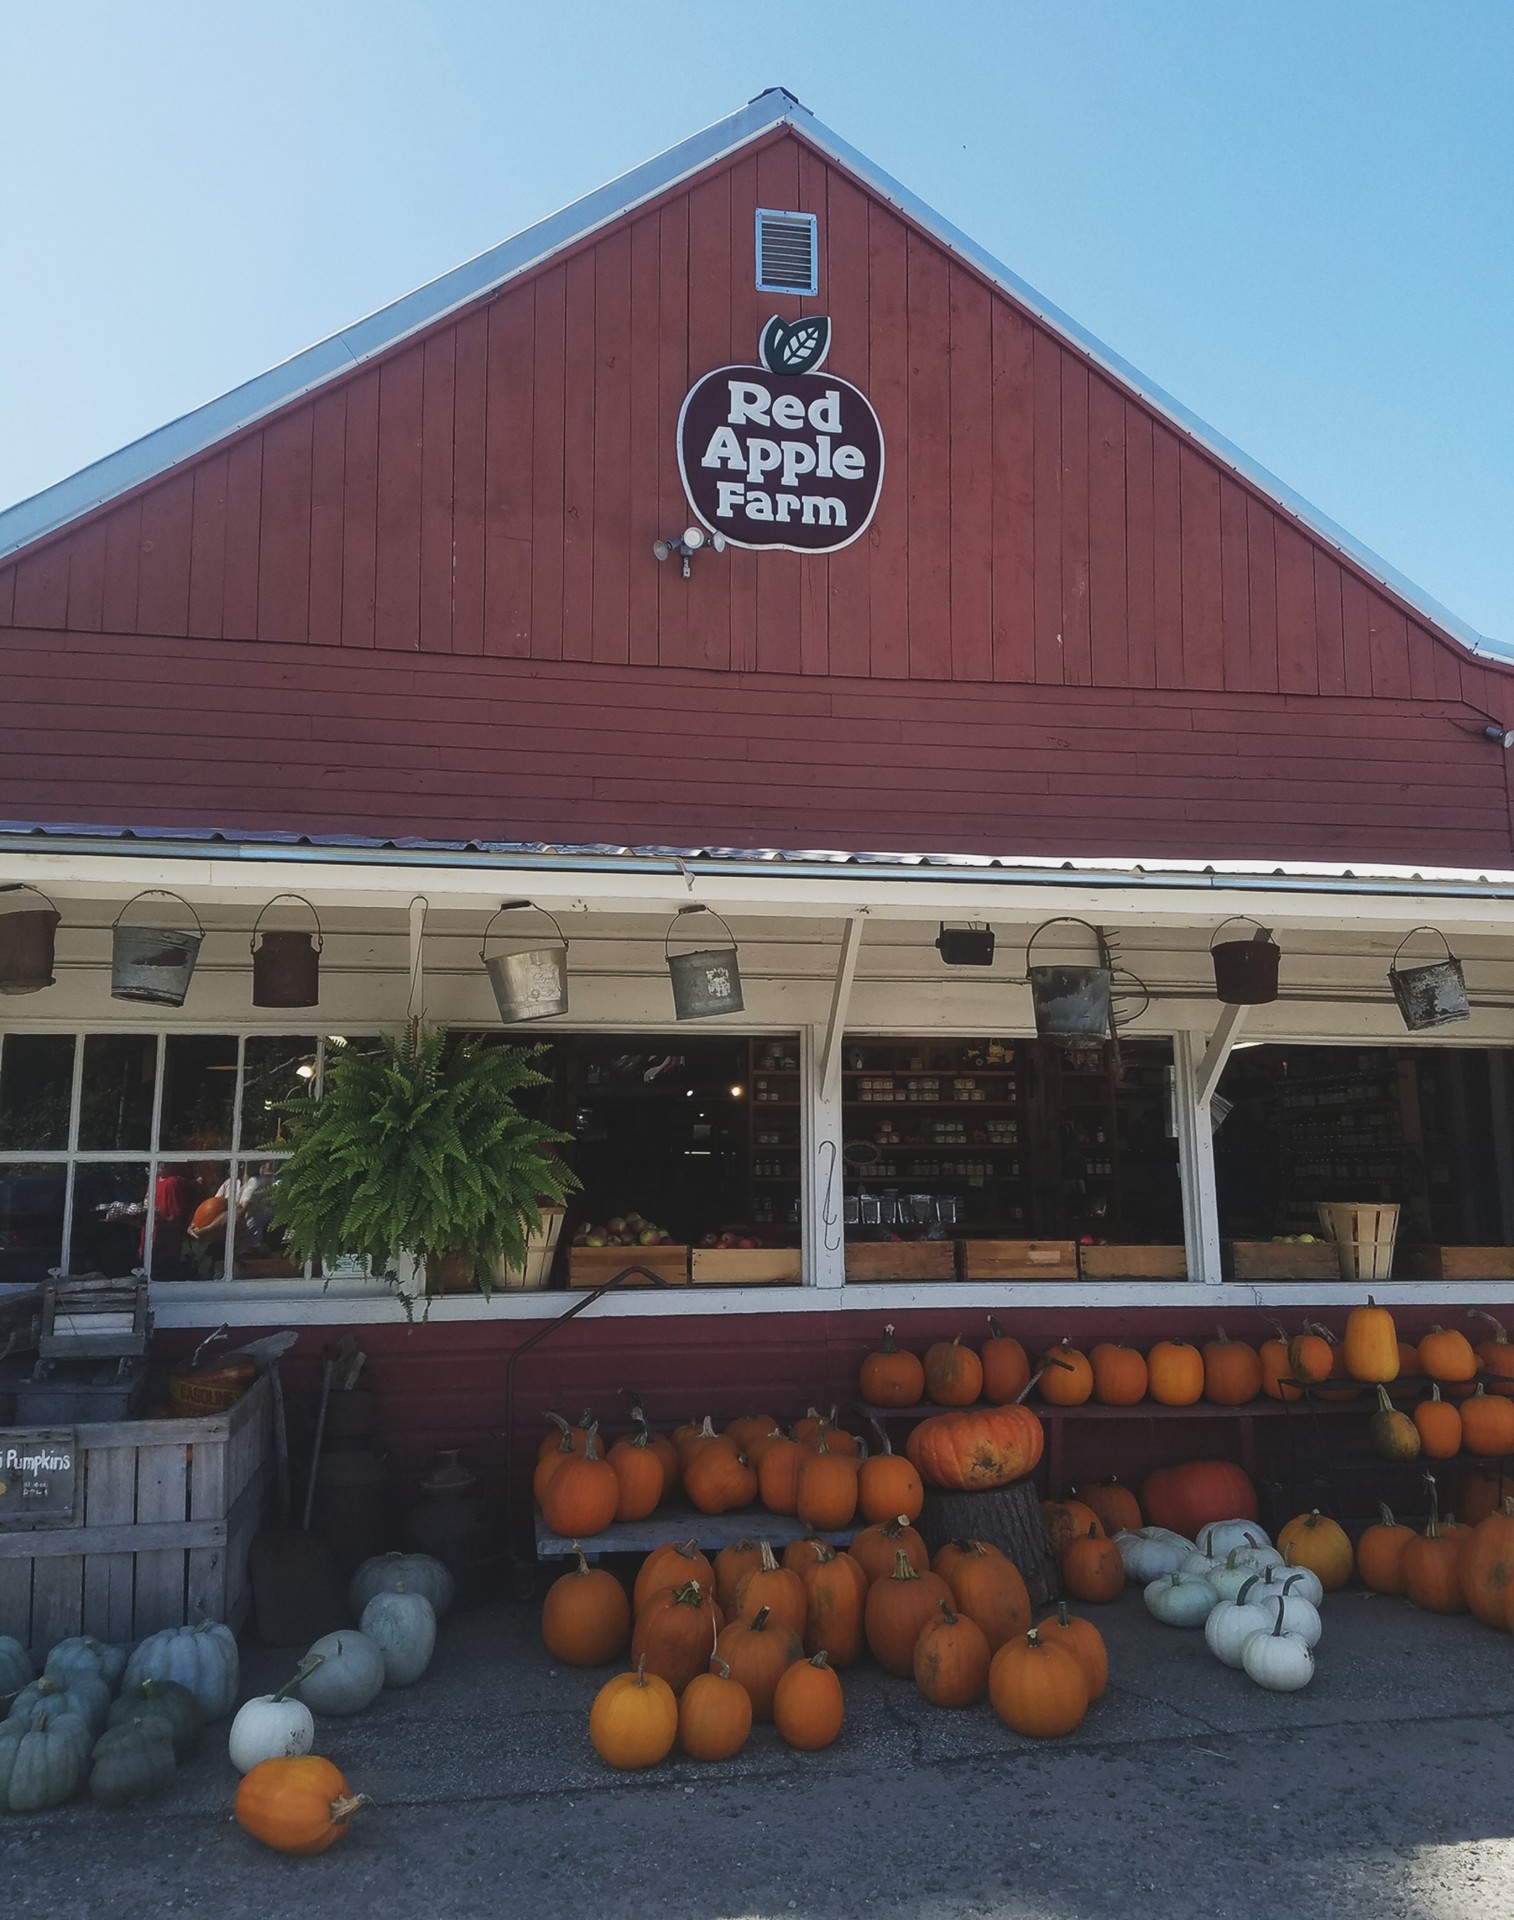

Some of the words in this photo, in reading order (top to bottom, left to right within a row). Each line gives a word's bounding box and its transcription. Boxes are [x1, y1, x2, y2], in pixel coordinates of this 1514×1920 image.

[727, 380, 842, 433] Red
[701, 426, 866, 486] Apple
[716, 481, 848, 526] Farm
[6, 1449, 71, 1477] Pumpkins
